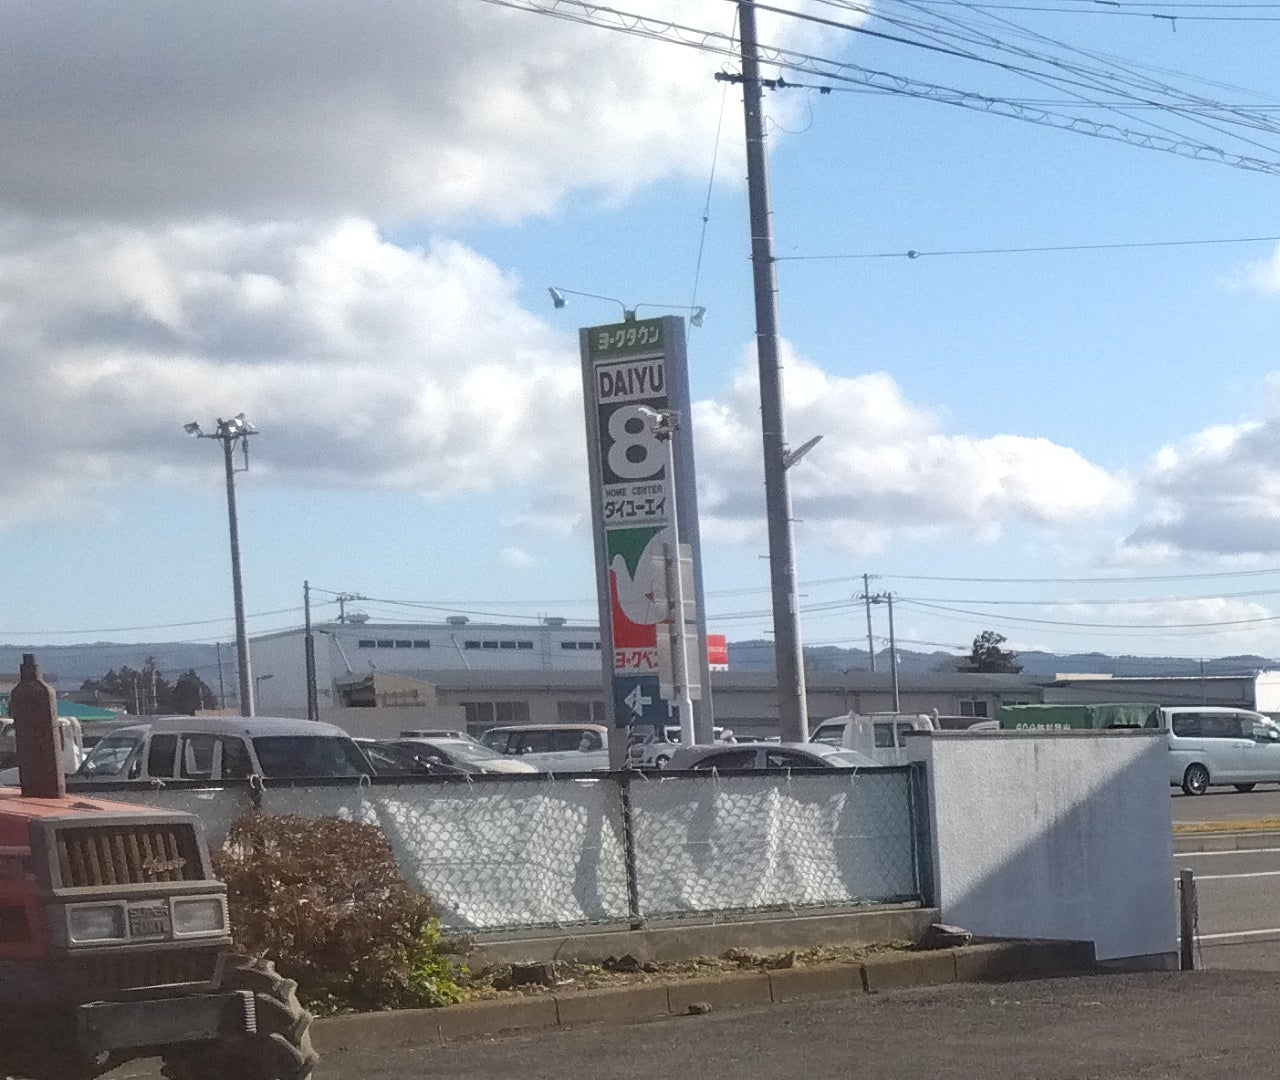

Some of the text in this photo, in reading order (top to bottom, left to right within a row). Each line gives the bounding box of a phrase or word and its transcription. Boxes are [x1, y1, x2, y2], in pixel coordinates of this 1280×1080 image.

[599, 326, 659, 350] ヨークタウン
[600, 364, 664, 397] DAIYU
[608, 404, 668, 479] 8
[605, 485, 663, 498] HOME CENTER
[605, 497, 666, 519] ダイユーエイ
